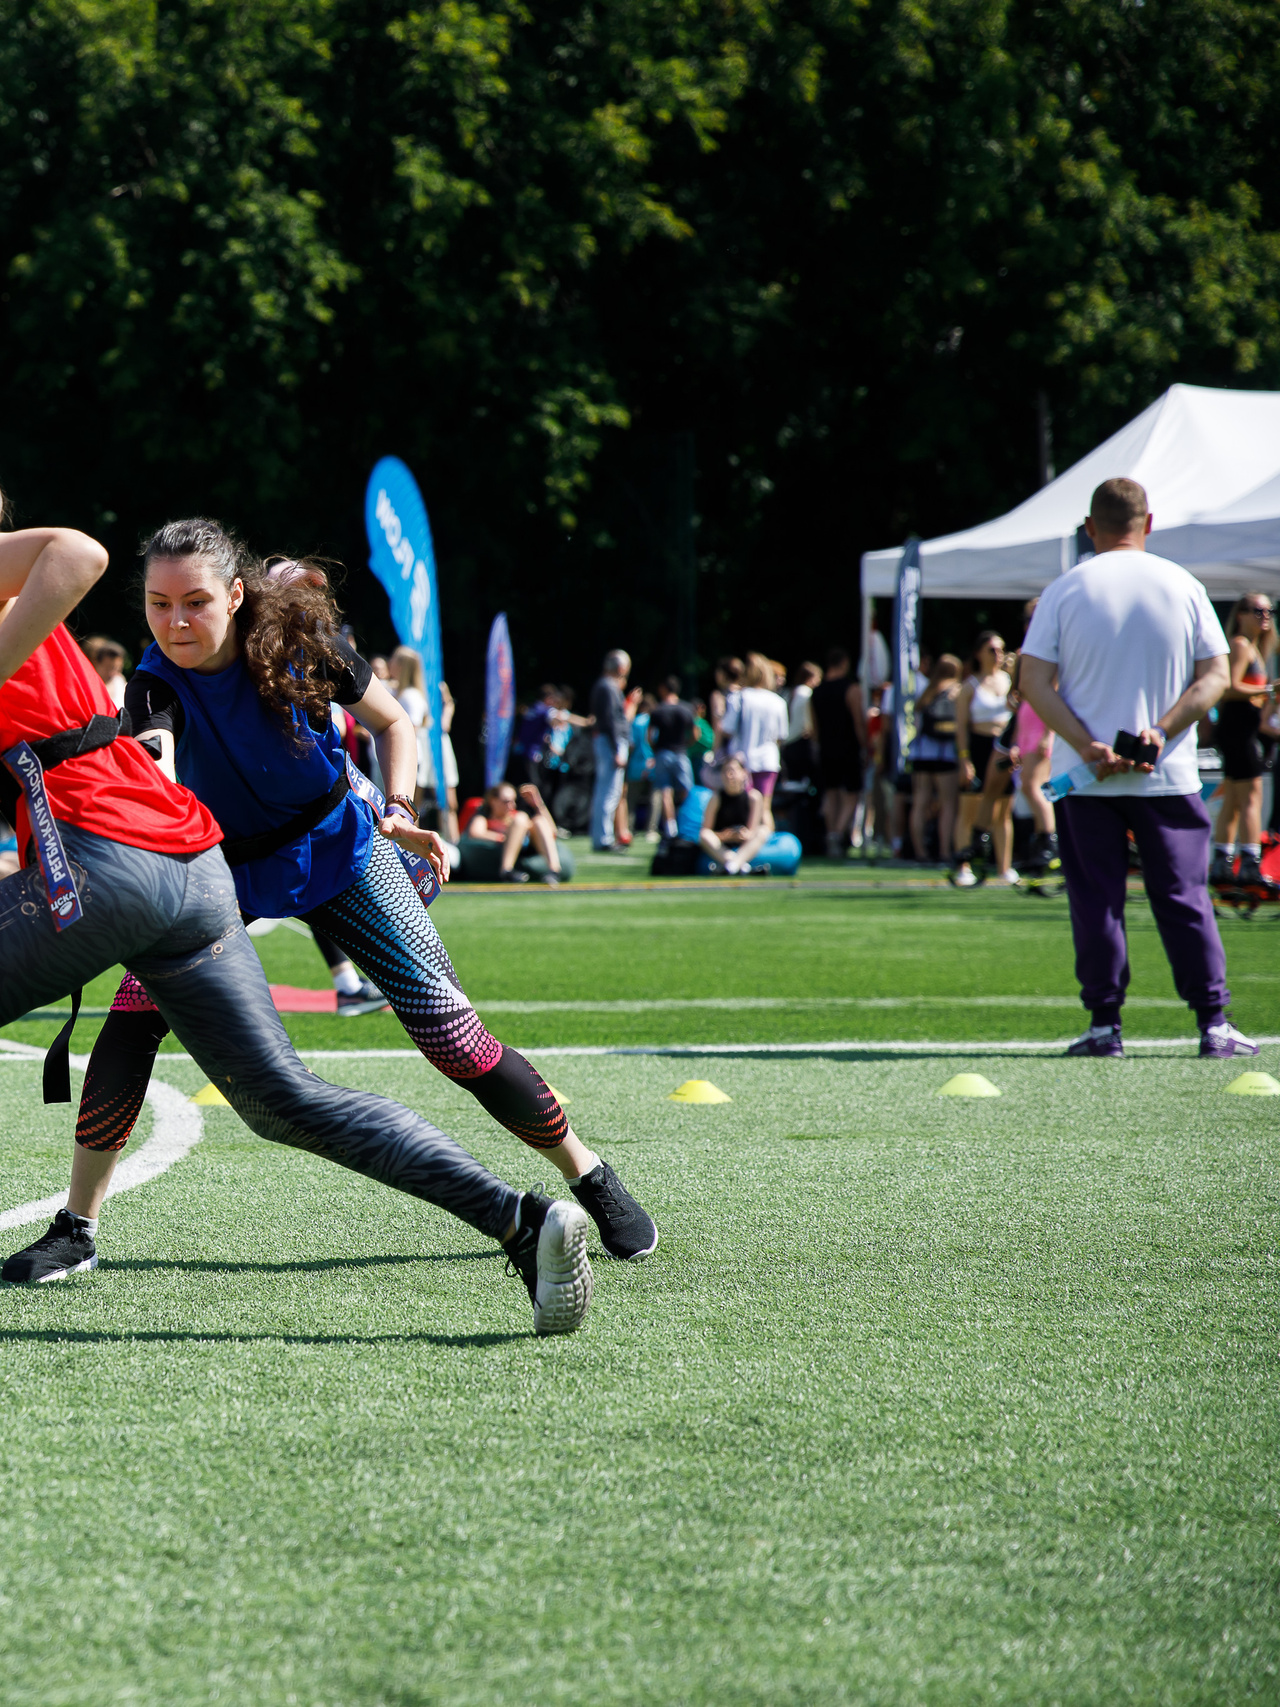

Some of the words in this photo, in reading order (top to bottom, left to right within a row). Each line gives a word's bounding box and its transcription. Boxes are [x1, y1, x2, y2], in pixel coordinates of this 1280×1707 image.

[17, 750, 42, 798] ЦСКА
[33, 796, 66, 883] РЕГБИ-КЛУБ
[50, 891, 76, 912] ЦСКА
